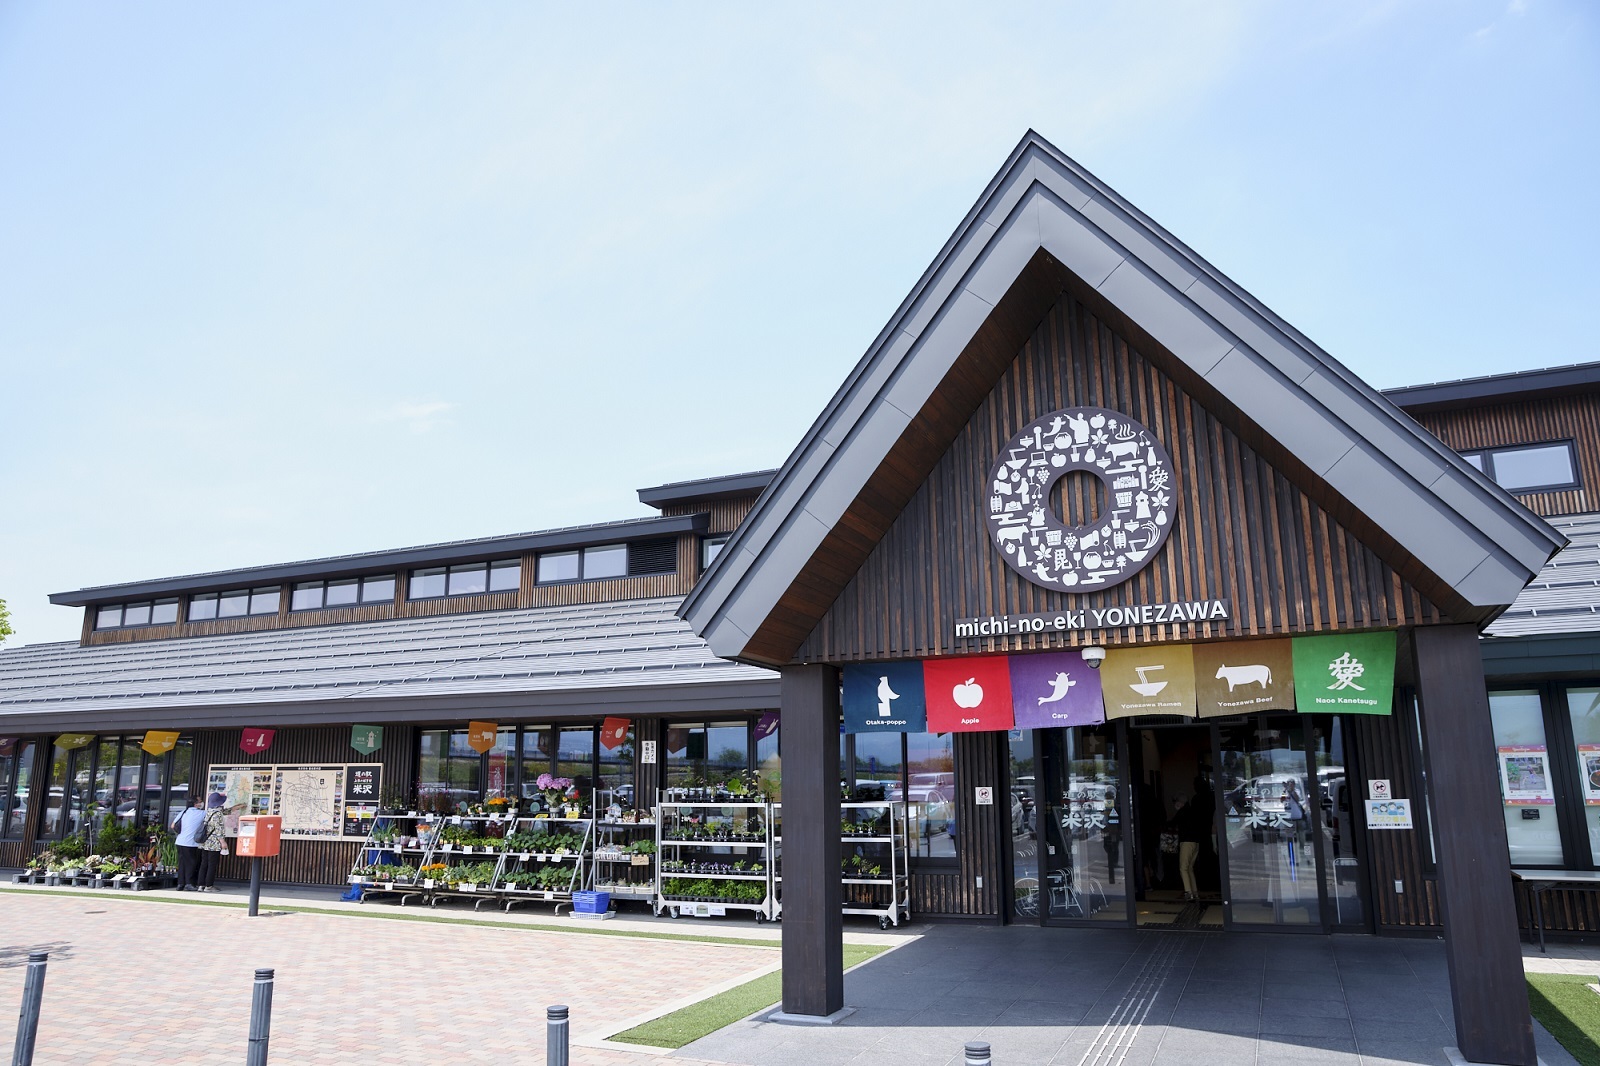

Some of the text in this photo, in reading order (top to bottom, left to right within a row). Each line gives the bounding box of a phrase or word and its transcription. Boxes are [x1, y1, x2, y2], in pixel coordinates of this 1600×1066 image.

[955, 600, 1228, 637] michi-no-eki YONEZAWA
[1326, 652, 1366, 691] 愛
[1121, 701, 1156, 709] Yonezawa
[1217, 698, 1255, 707] Yonezawa
[1337, 697, 1378, 705] Kanetsugu
[1051, 712, 1069, 720] Carp
[961, 717, 980, 725] Apple
[353, 784, 372, 794] 米沢
[1062, 813, 1106, 829] 米沢
[1244, 812, 1293, 828] 米沢
